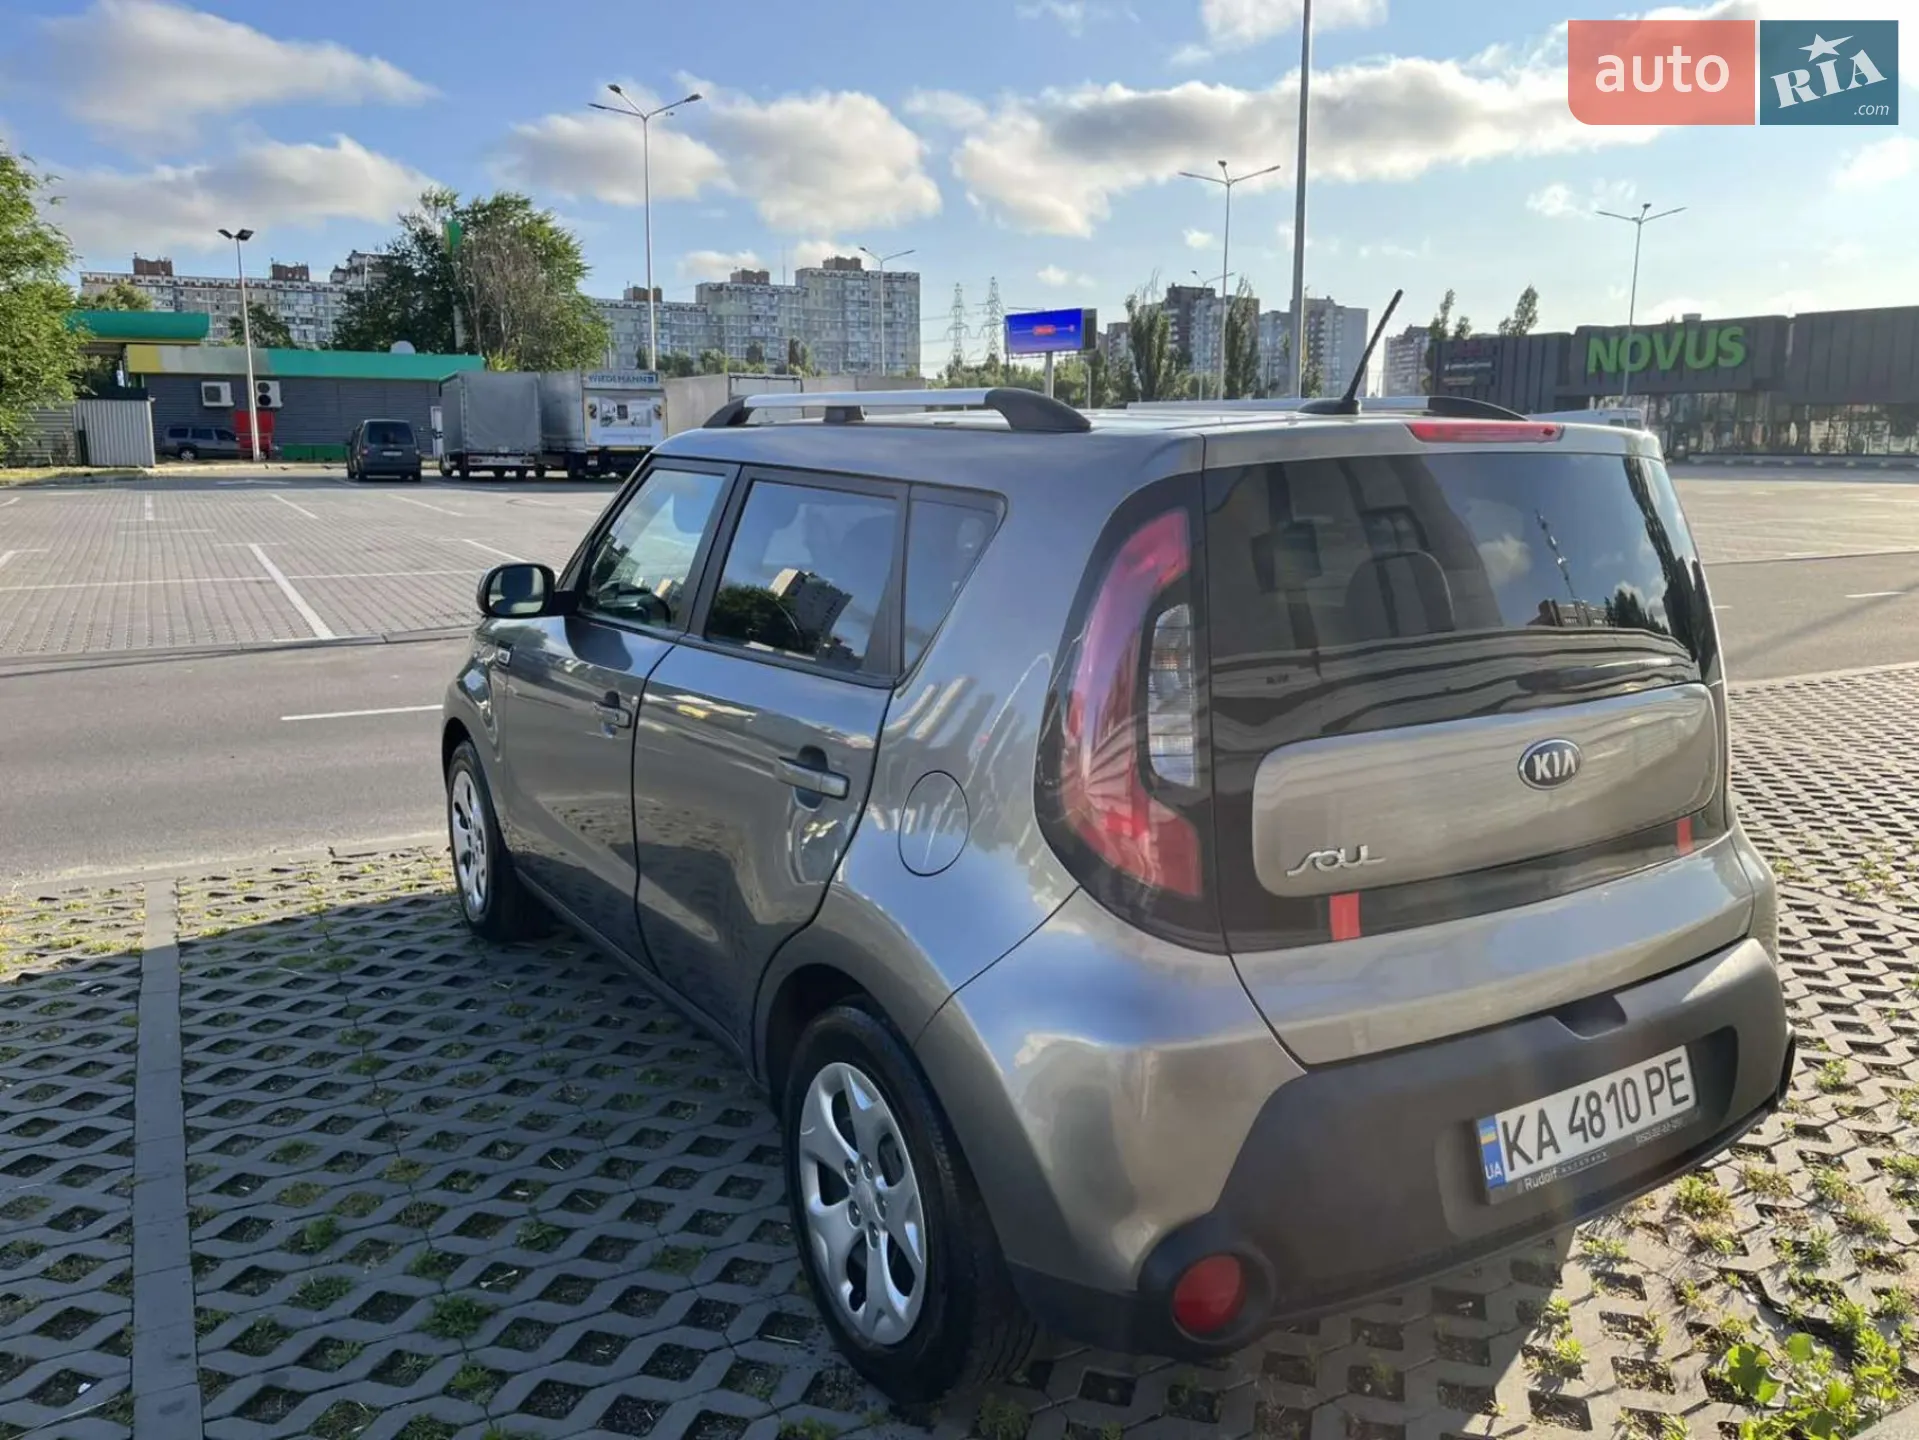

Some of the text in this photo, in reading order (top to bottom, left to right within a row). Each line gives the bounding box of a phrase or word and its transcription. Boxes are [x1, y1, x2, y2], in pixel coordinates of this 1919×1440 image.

[1587, 326, 1746, 375] NOVUS
[1532, 749, 1577, 781] KIA
[1501, 1108, 1561, 1172] KA
[1568, 1077, 1641, 1144] 4810
[1644, 1056, 1690, 1116] PE
[1485, 1160, 1502, 1180] UA
[1524, 1166, 1558, 1192] Rudolf
